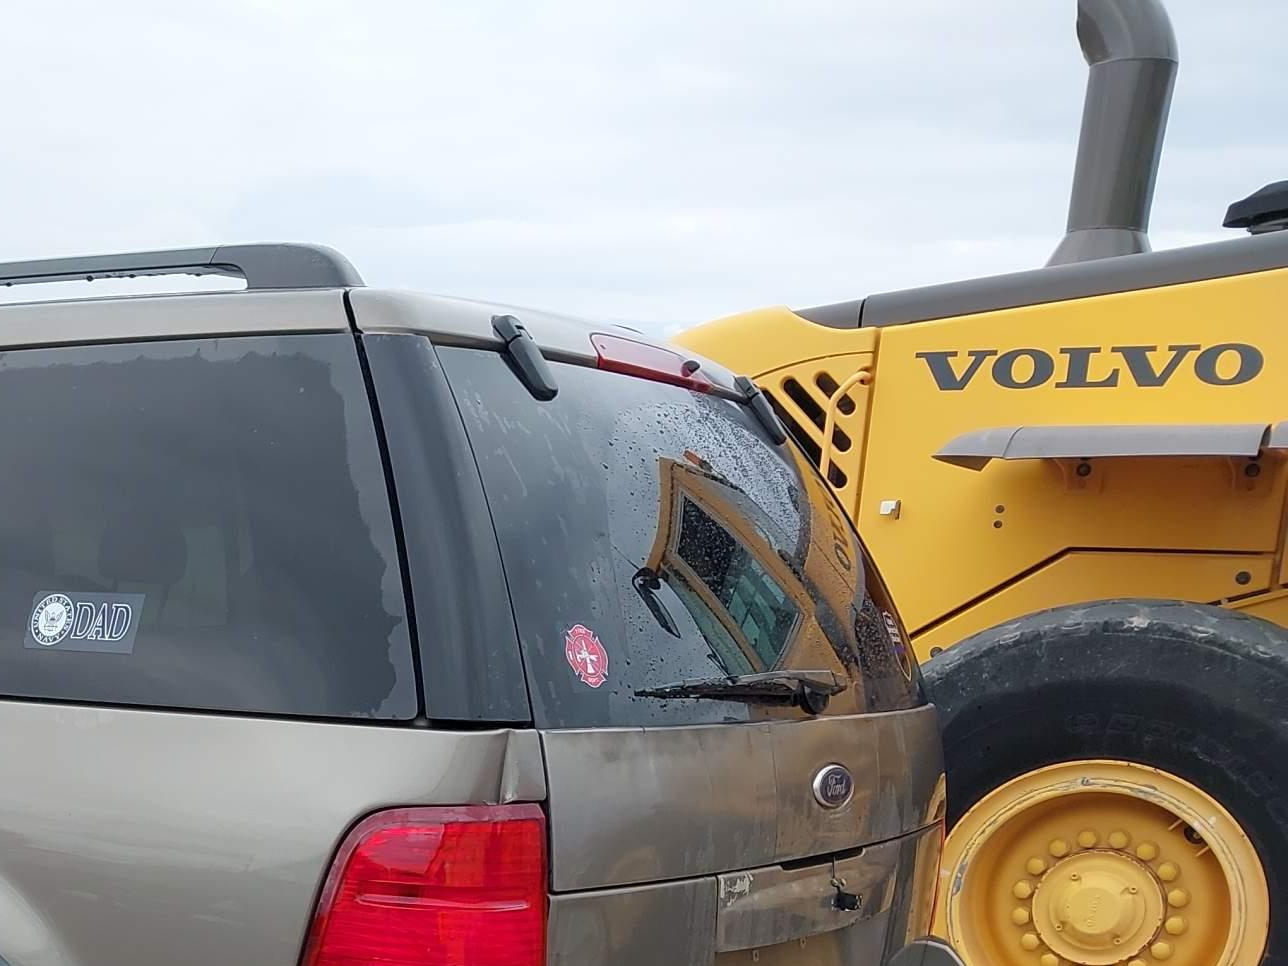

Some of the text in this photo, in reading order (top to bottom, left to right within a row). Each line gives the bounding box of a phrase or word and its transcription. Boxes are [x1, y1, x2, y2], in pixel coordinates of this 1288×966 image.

[915, 343, 1264, 391] VOLVO
[37, 630, 62, 643] NAVY
[70, 602, 132, 642] DAD
[826, 773, 846, 797] Ford
